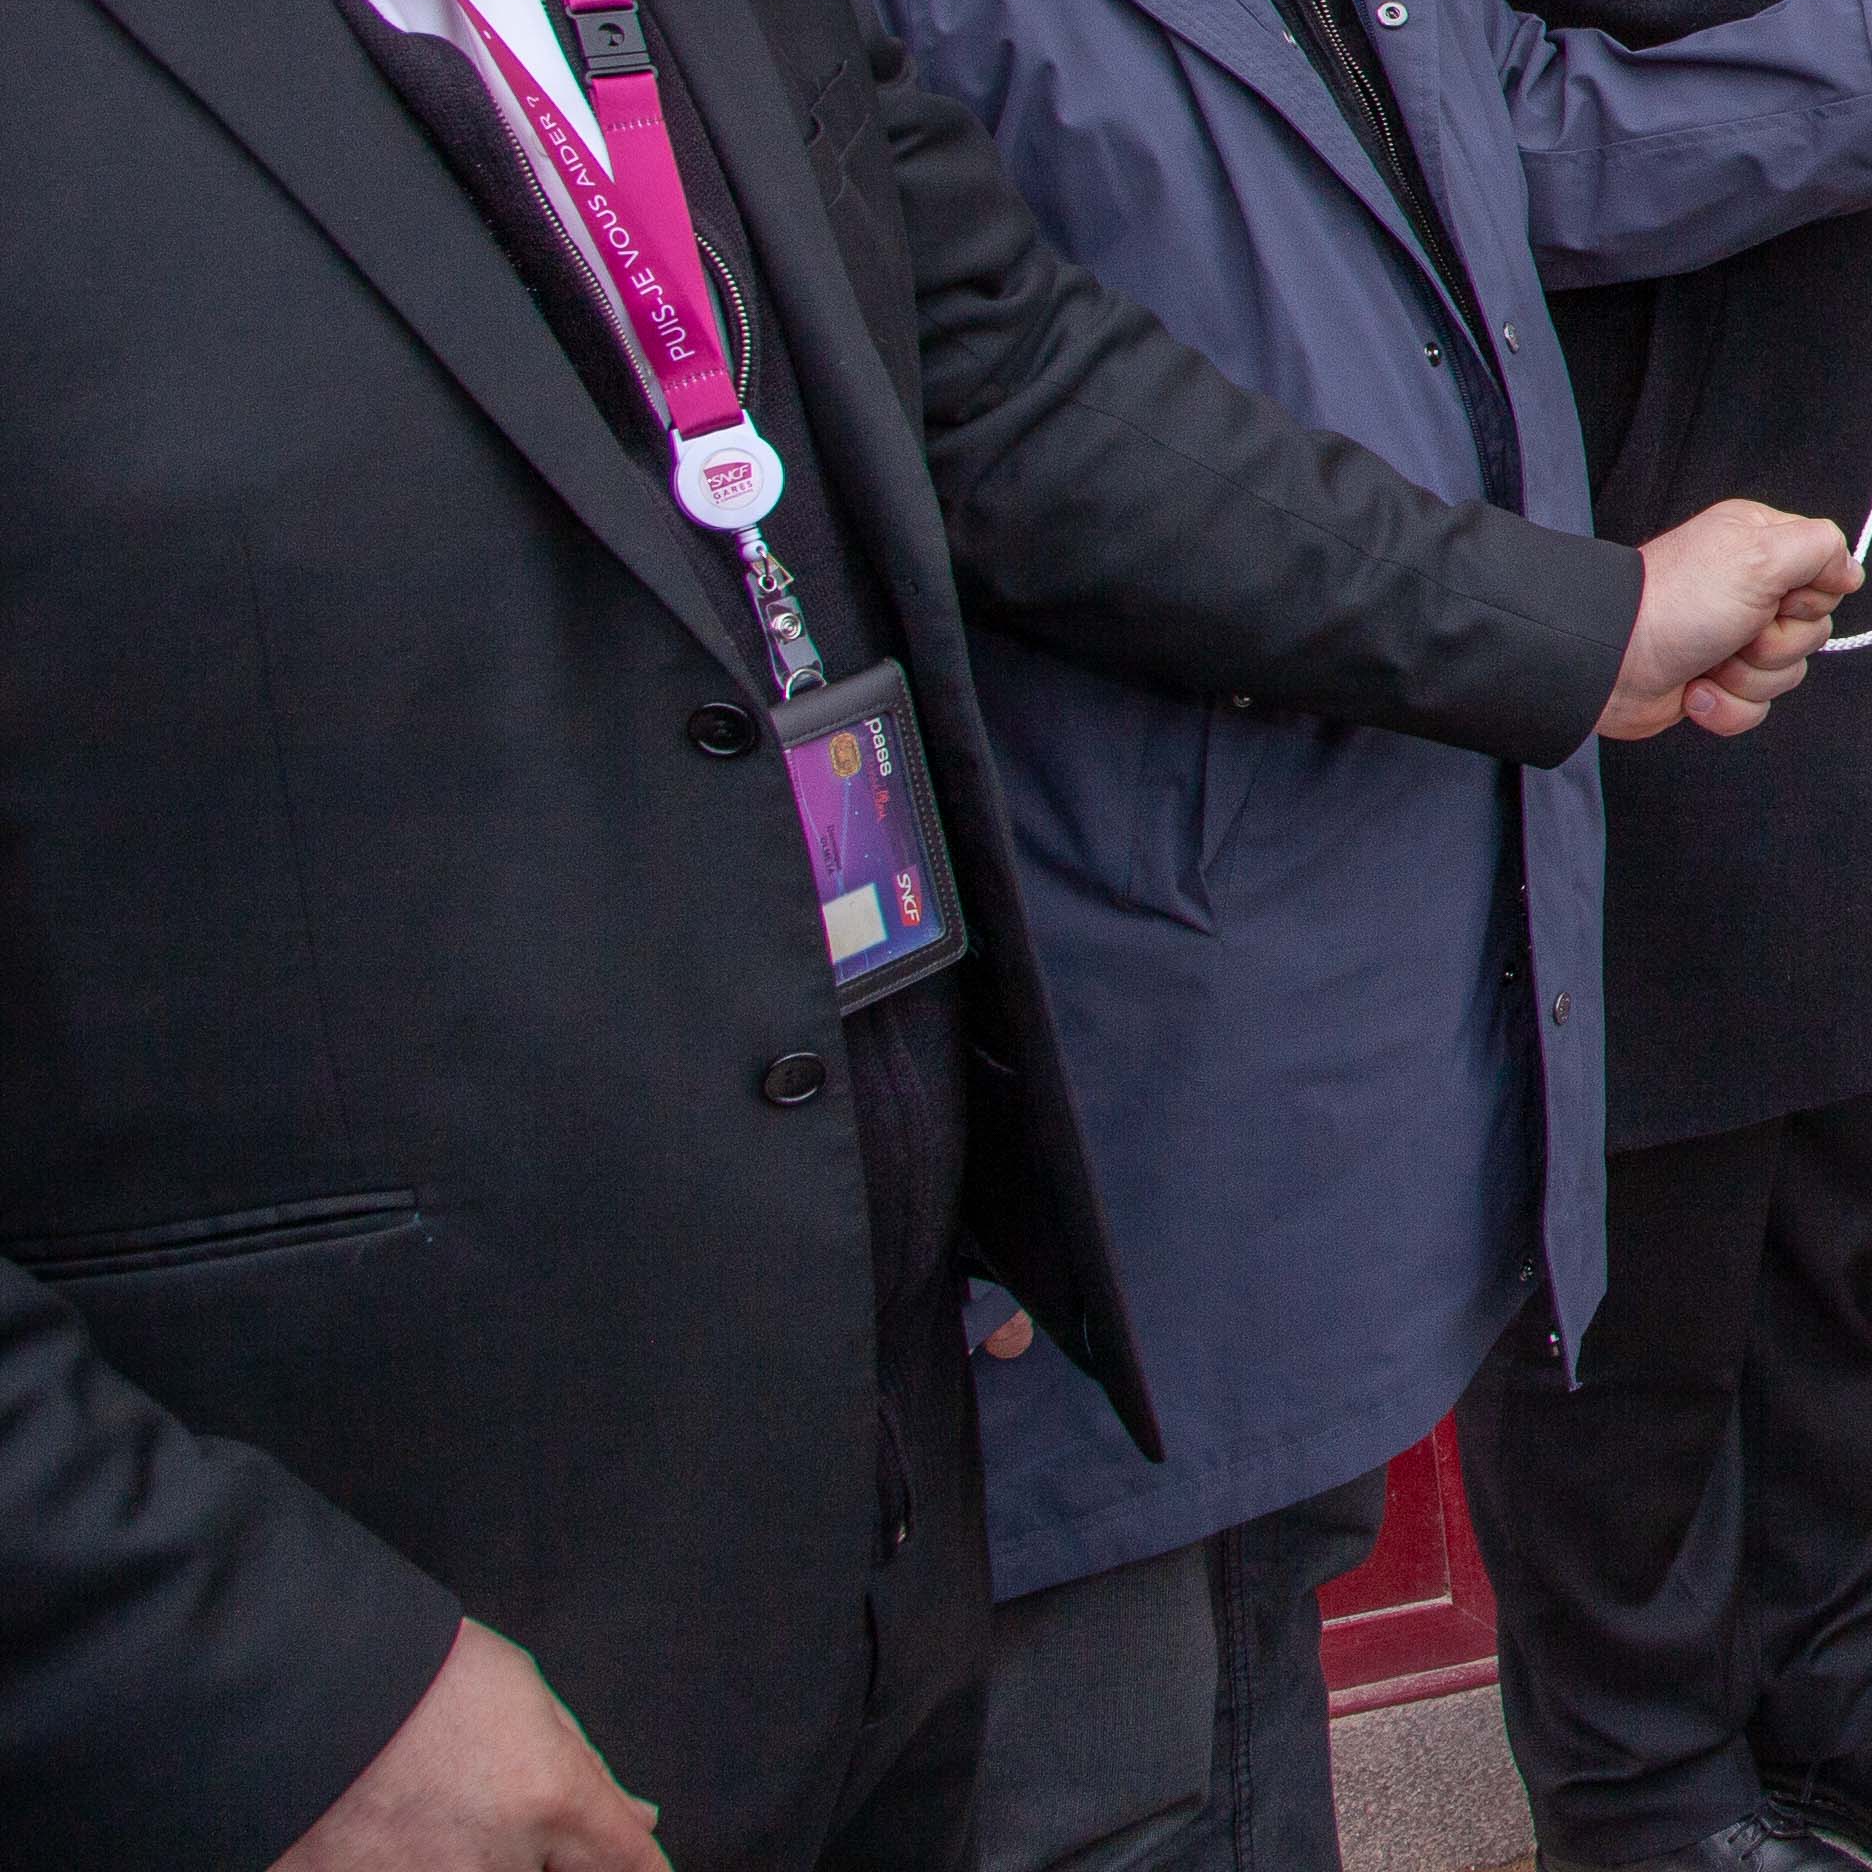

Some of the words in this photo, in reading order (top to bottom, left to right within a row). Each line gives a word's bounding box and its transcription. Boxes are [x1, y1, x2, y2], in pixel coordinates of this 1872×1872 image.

[526, 95, 540, 108] ?
[539, 112, 596, 187] AIDER
[587, 194, 639, 269] VOUS
[630, 266, 695, 361] PUIS-JE
[711, 463, 751, 489] SNCF
[713, 481, 752, 500] GARES
[864, 717, 892, 776] pass
[896, 872, 920, 922] SNCF
